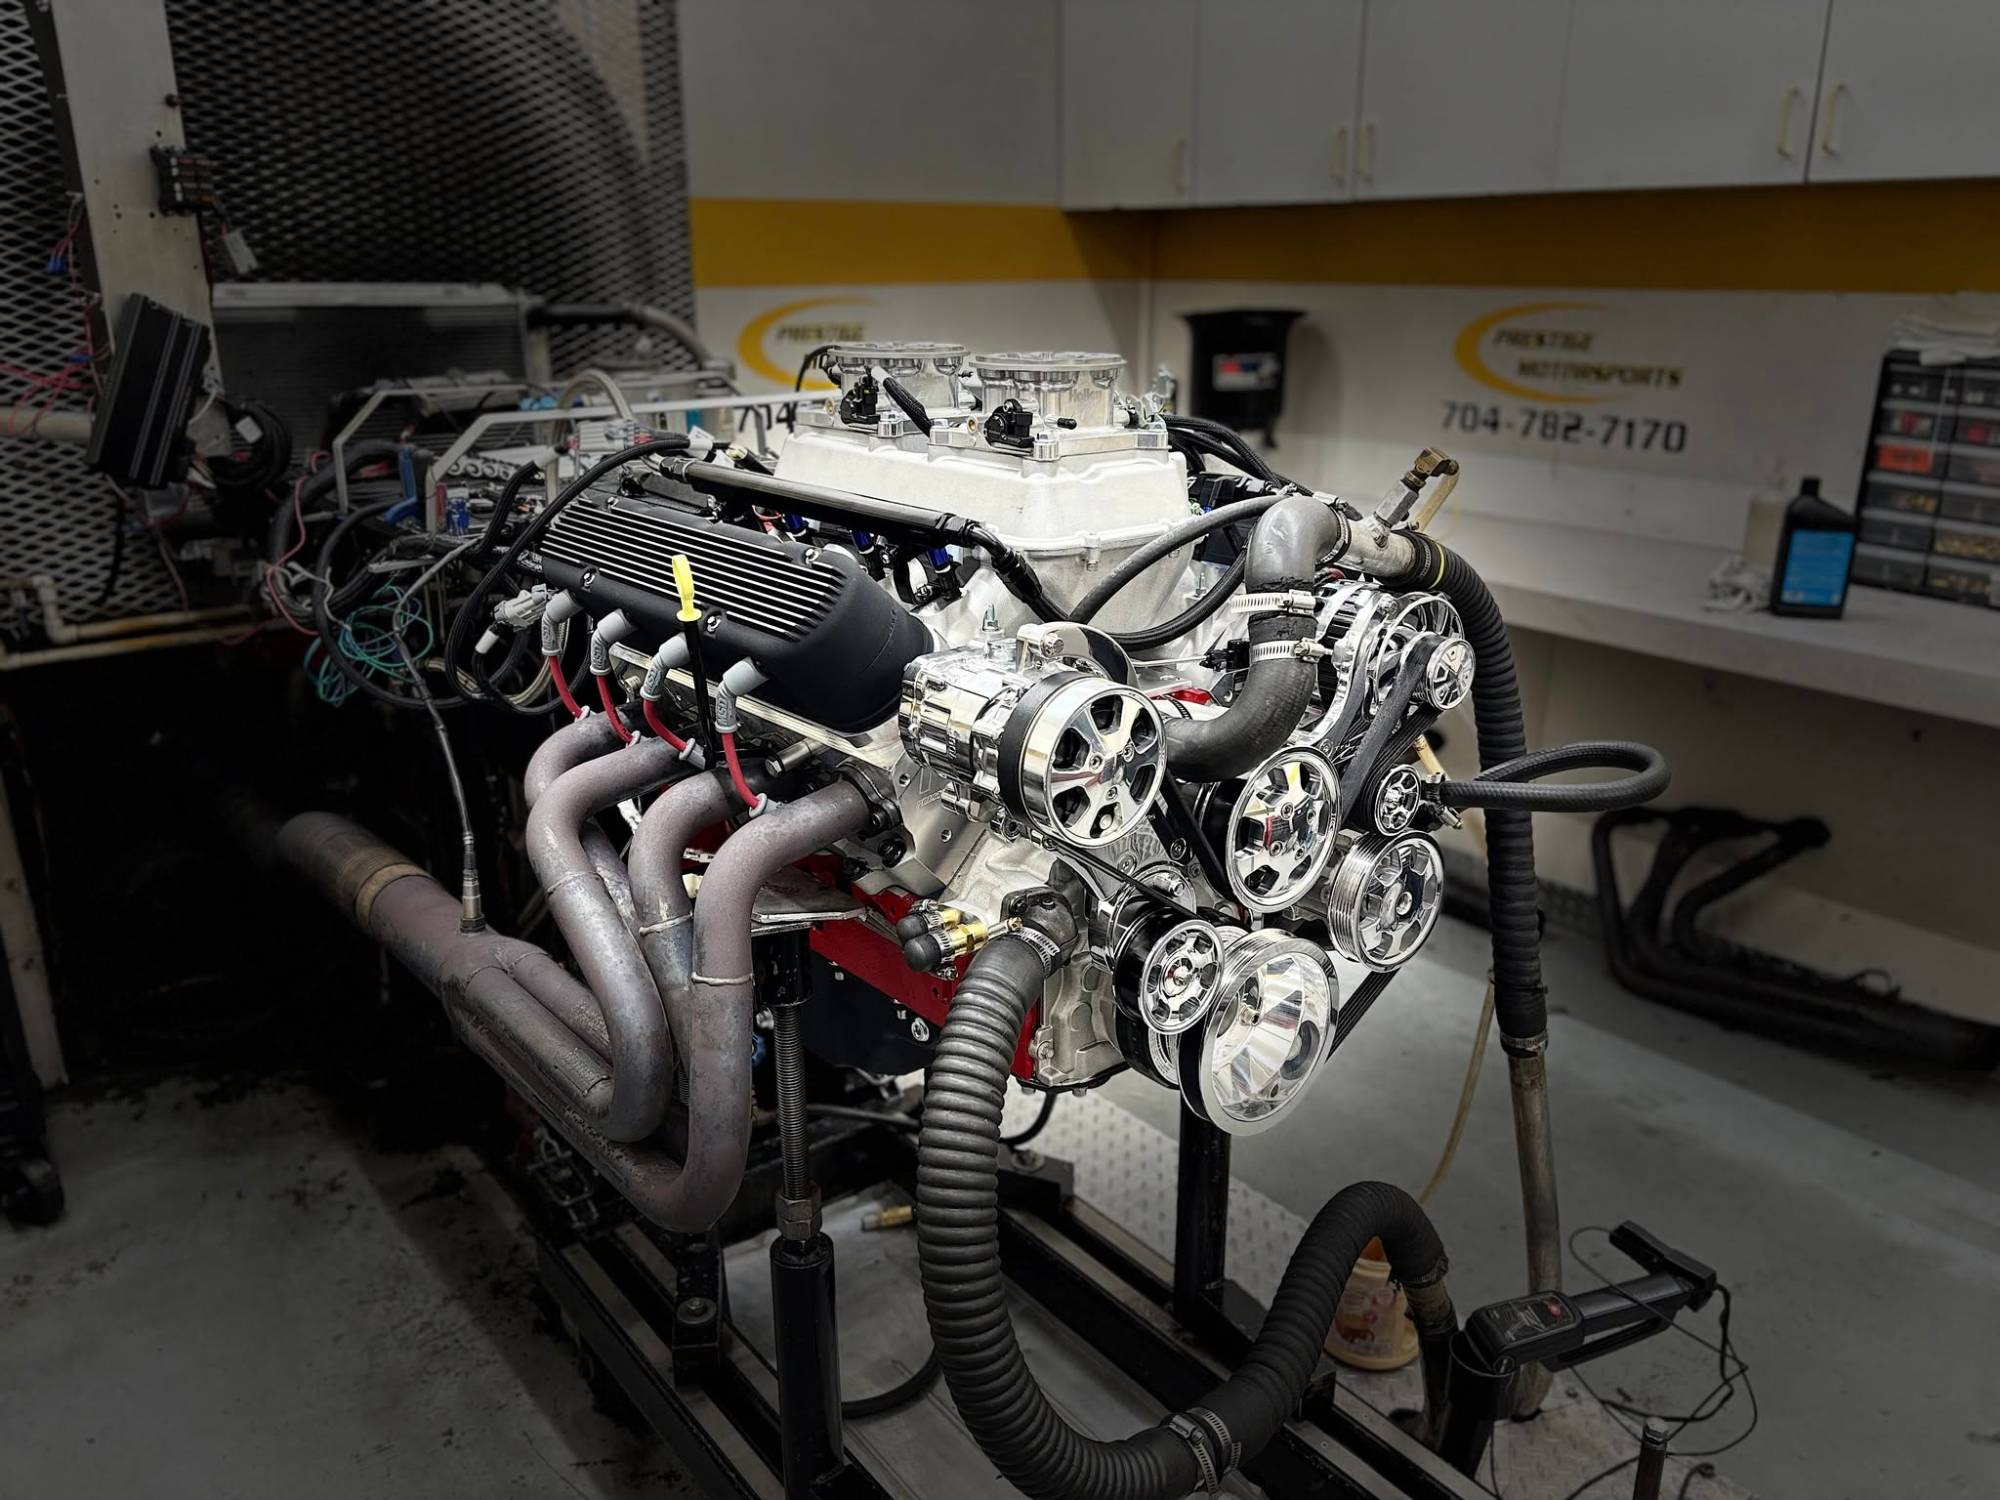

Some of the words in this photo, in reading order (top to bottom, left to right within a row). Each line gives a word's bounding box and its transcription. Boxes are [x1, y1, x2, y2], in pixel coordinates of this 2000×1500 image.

[1494, 329, 1595, 350] PRESTIGE
[1517, 359, 1681, 387] MOTORSPORTS
[1442, 402, 1687, 452] 704-782-7170
[718, 698, 728, 725] MSD
